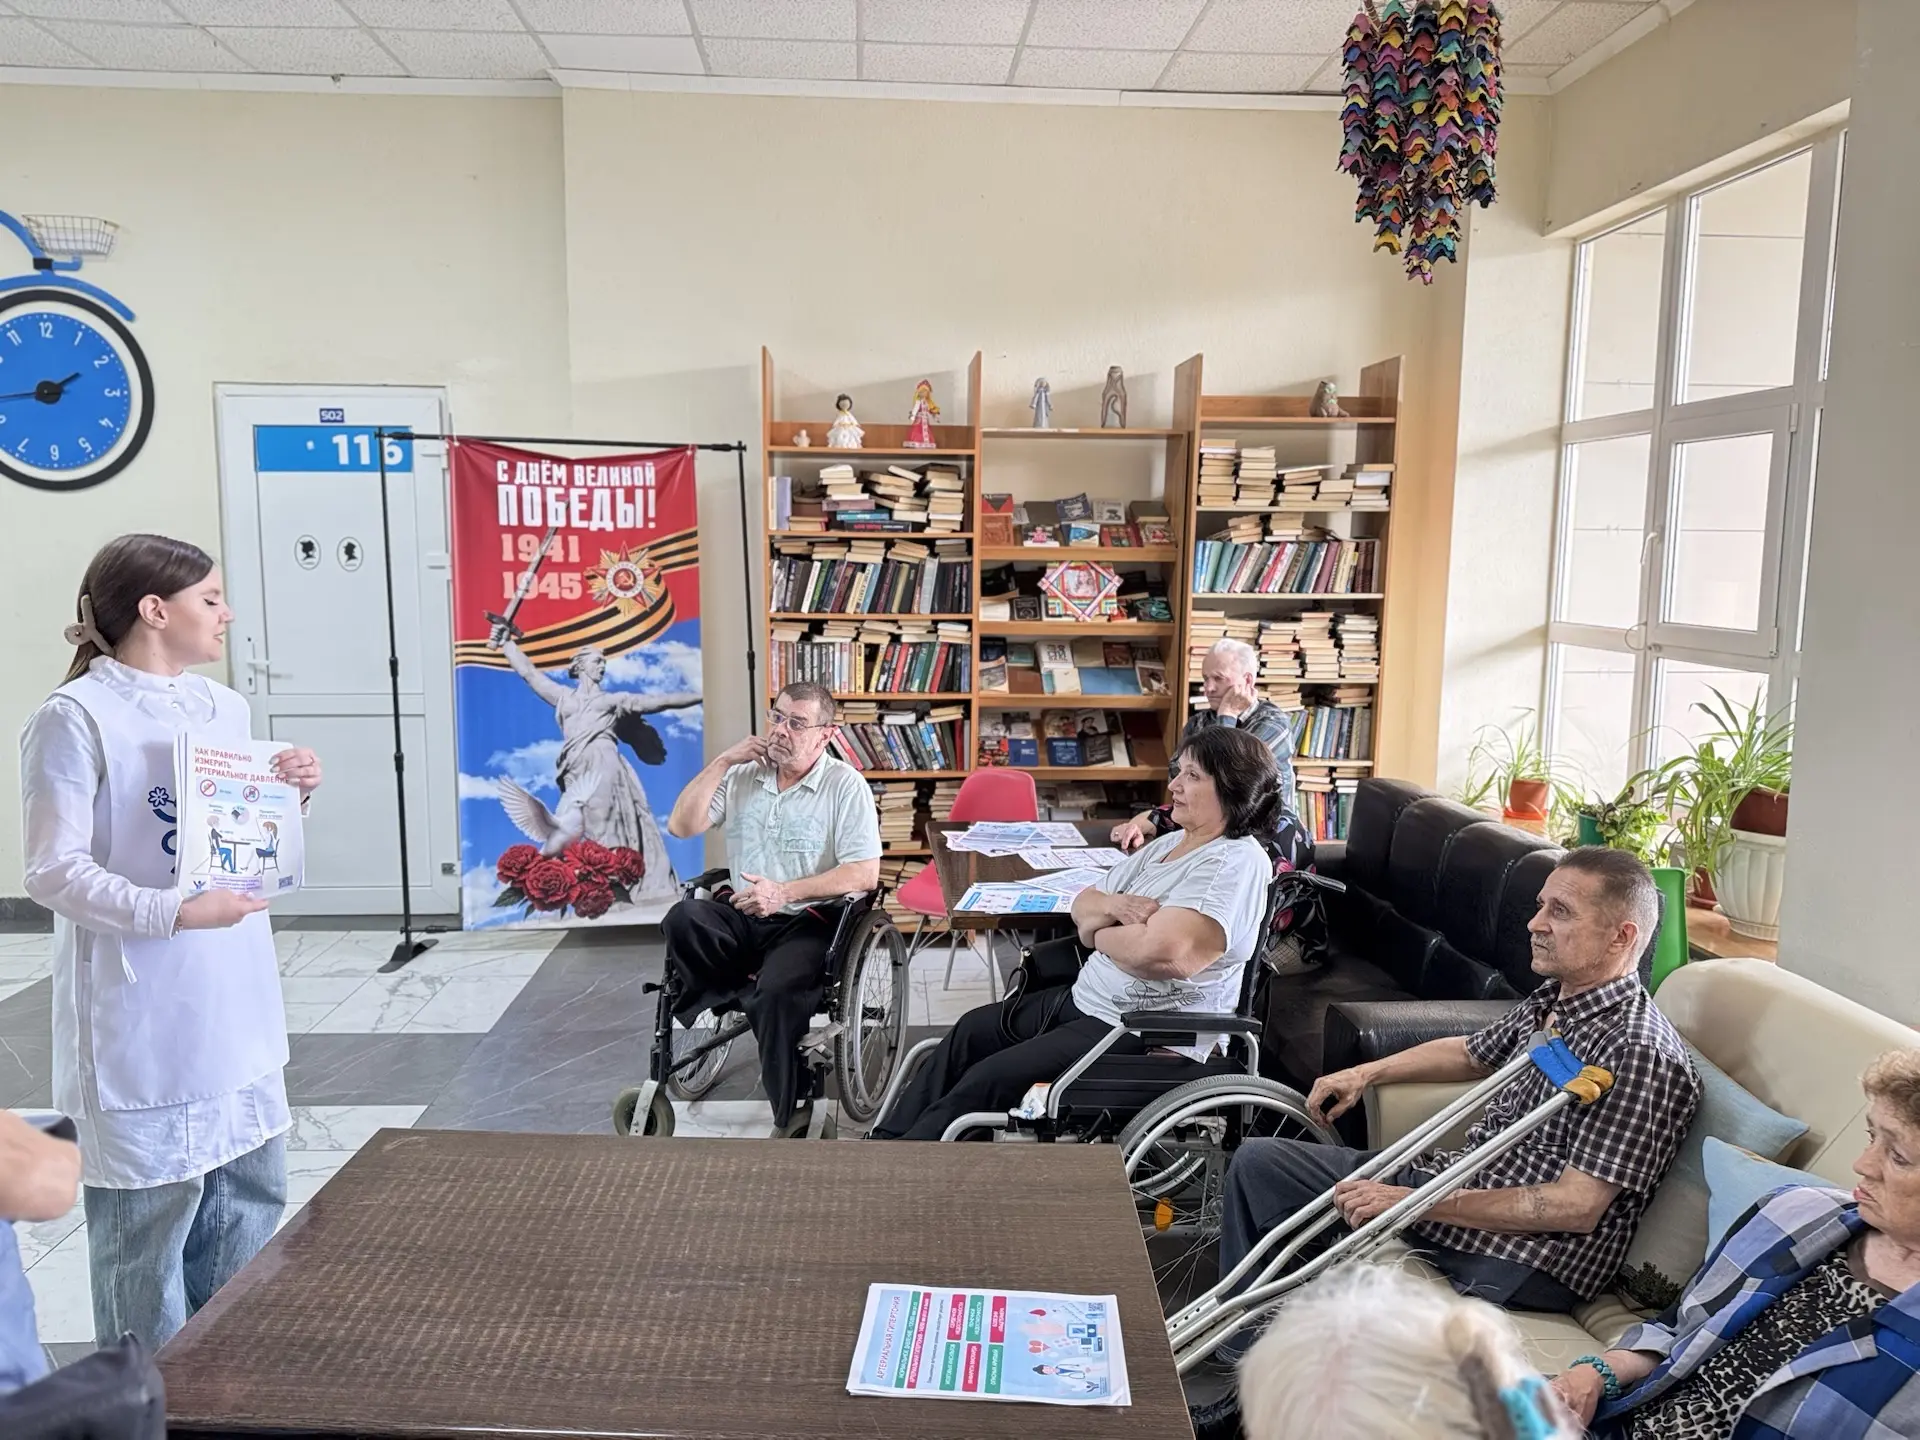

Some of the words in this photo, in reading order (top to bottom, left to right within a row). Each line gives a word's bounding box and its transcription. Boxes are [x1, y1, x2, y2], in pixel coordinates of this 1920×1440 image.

[6, 329, 23, 347] 11
[38, 321, 54, 339] 12
[73, 331, 83, 346] 1
[93, 355, 110, 369] 2
[104, 388, 121, 398] 3
[98, 417, 114, 429] 4
[17, 437, 30, 453] 7
[50, 444, 60, 461] 6
[78, 436, 93, 453] 5
[331, 433, 404, 466] 116
[496, 460, 509, 482] С
[513, 460, 567, 486] ДНЁМ
[573, 462, 656, 487] ВЕЛИКОЙ
[497, 485, 657, 531] ПОБЕДЫ!
[500, 533, 581, 563] 1941
[502, 572, 583, 600] 1945
[194, 746, 209, 755] КАК
[210, 749, 252, 763] ПРАВИЛЬНО
[194, 756, 232, 769] ИЗМЕРИТЬ
[194, 766, 248, 781] АРТЕРИАЛЬНОЕ
[876, 1333, 893, 1379] АРТЕРИАЛЬНАЯ
[889, 1296, 901, 1333] ГИПЕРТОНИЯ
